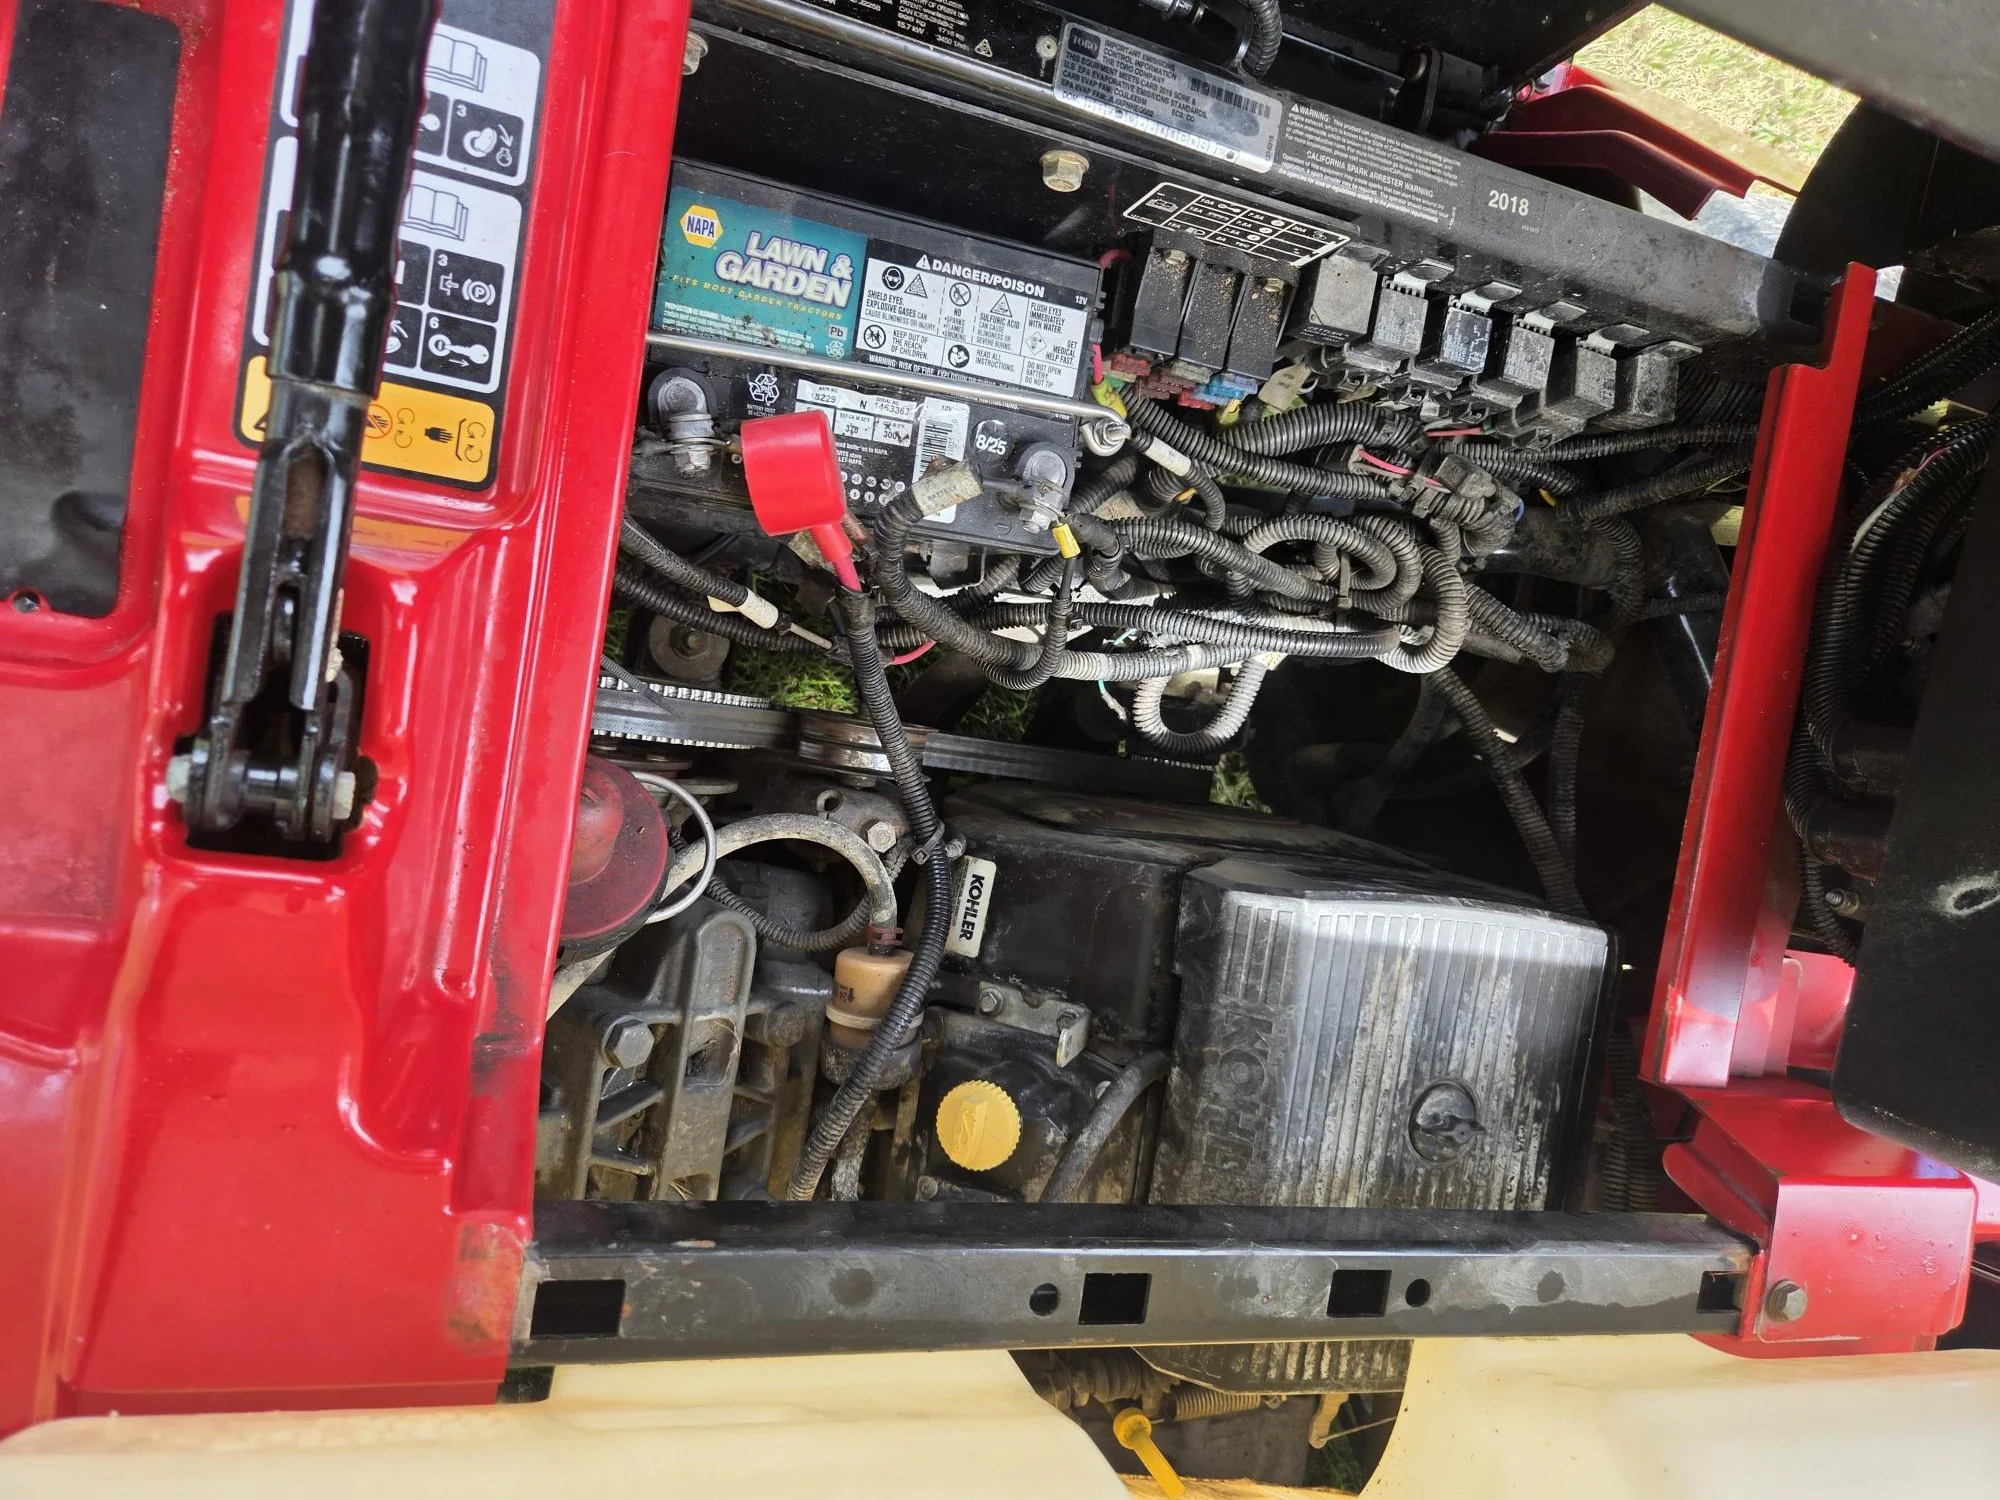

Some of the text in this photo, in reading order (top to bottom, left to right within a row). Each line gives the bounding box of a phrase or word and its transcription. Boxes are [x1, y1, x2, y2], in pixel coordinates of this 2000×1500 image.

[895, 20, 911, 30] 15.7
[911, 25, 924, 34] kW
[1070, 35, 1098, 51] TORO
[1103, 39, 1176, 71] IMPORTANT EMISSIONS
[1064, 51, 1081, 62] THIS
[1080, 57, 1118, 75] EQUIPMENT
[1117, 70, 1140, 84] MEETS
[1101, 56, 1165, 84] THE TORO COMPANY
[1102, 47, 1177, 80] CONTROL INFORMATION
[1060, 78, 1075, 88] EPA
[1074, 83, 1091, 94] EVAP
[1061, 69, 1080, 81] CARB
[1079, 76, 1098, 88] EVAP
[1077, 65, 1090, 75] EPA
[1090, 70, 1137, 92] EVAPORATIVE
[1135, 86, 1170, 104] EMISSIONS
[456, 104, 467, 118] 3
[1297, 105, 1330, 122] WARNING:
[1305, 150, 1434, 198] CALIFORNIA SPARK ARRESTER WARNING
[1486, 189, 1531, 216] 2018
[684, 214, 717, 238] NAPA
[437, 254, 448, 267] 3
[745, 230, 857, 281] LAWN &
[712, 248, 852, 309] GARDEN
[930, 258, 1046, 298] DANGER/POISON
[671, 274, 842, 321] FITS MOST GARDEN TRACTORS
[867, 289, 905, 306] SHIELD EYES.
[1074, 294, 1088, 305] 12V
[866, 298, 927, 320] EXPLOSIVE GASES CAN
[953, 308, 962, 316] NO
[1030, 302, 1062, 316] FLUSH EYES
[429, 317, 439, 329] 6
[864, 308, 881, 318] CAUSE
[881, 312, 909, 325] BLINDNESS
[909, 319, 918, 327] OR
[979, 312, 1020, 329] SULFURIC ACID
[1029, 310, 1065, 326] IMMEDIATELY
[830, 325, 844, 337] Pb
[978, 320, 1004, 332] CAN CAUSE
[1028, 319, 1063, 333] WITH WATER.
[892, 329, 928, 343] KEEP OUT OF
[975, 335, 995, 346] SEVERE
[976, 328, 1011, 342] BLINDNESS OR
[892, 337, 922, 350] THE REACH
[1052, 345, 1076, 357] MEDICAL
[1066, 340, 1077, 349] GET
[890, 344, 929, 360] OF CHILDREN.
[975, 348, 1001, 361] READ ALL
[1045, 352, 1074, 365] HELP FAST.
[868, 353, 898, 368] WARNING:
[897, 360, 912, 370] RISK
[912, 364, 921, 372] OF
[974, 356, 1015, 372] INSTRUCTIONS.
[1026, 361, 1062, 375] DO NOT OPEN
[1032, 378, 1044, 386] NOT
[859, 399, 867, 409] N
[875, 396, 890, 404] SERIAL
[976, 434, 1007, 455] 8/25
[959, 873, 984, 941] KOHLER
